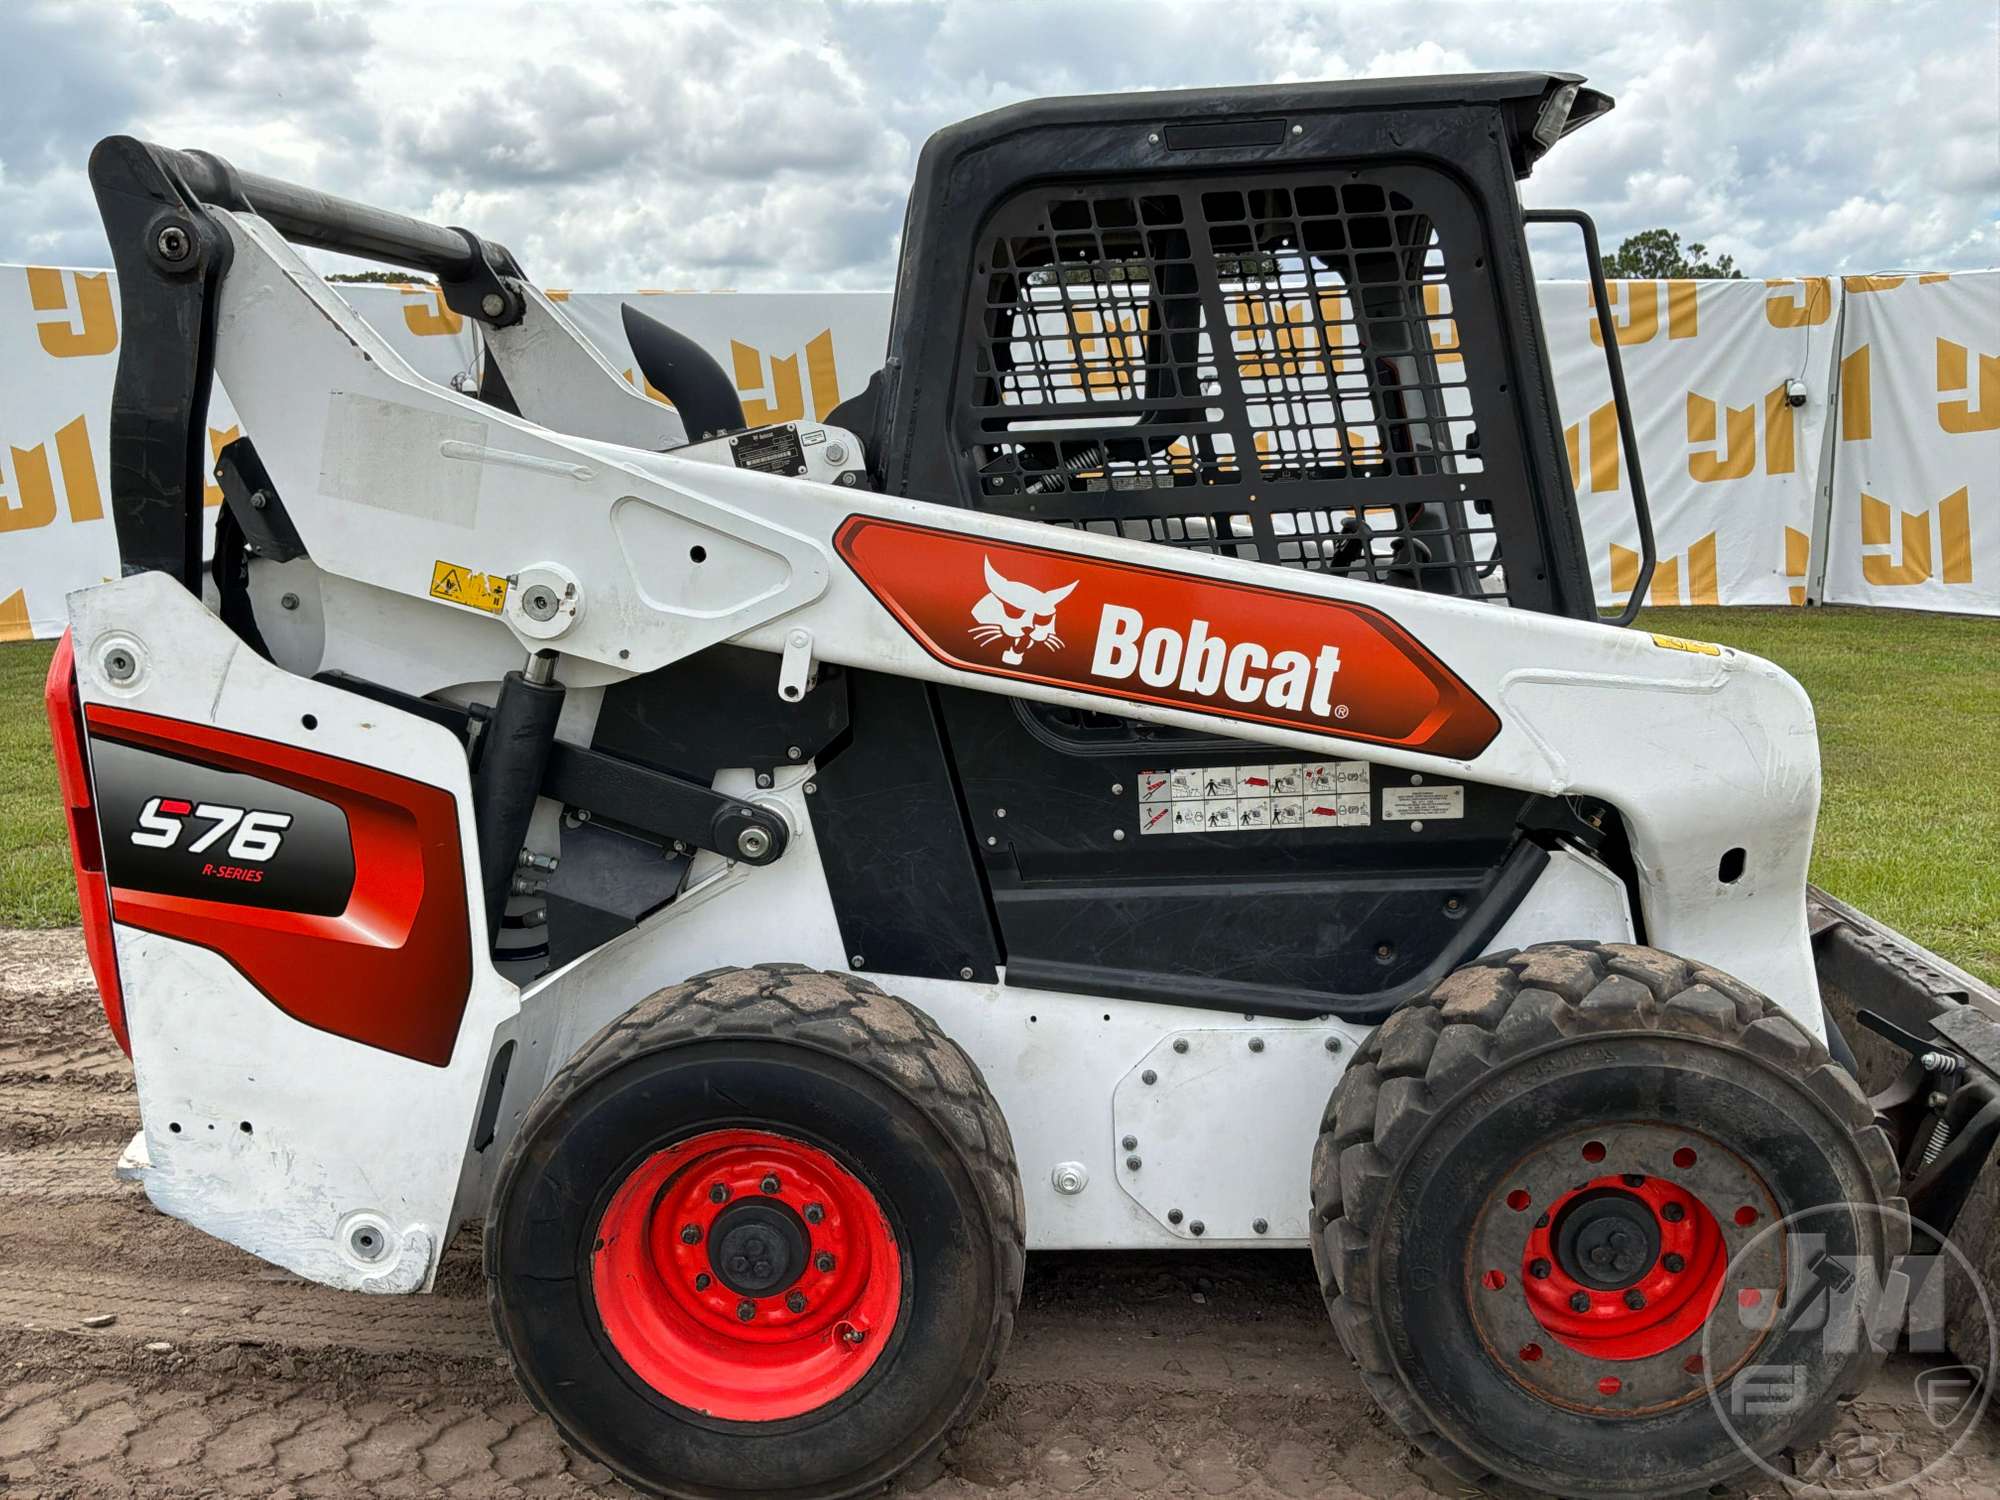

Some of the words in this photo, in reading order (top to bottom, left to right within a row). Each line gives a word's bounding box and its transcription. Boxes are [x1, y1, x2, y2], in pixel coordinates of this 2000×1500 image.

[1091, 604, 1341, 717] Bobcat
[130, 797, 293, 861] S76
[202, 864, 263, 882] R-SERIES
